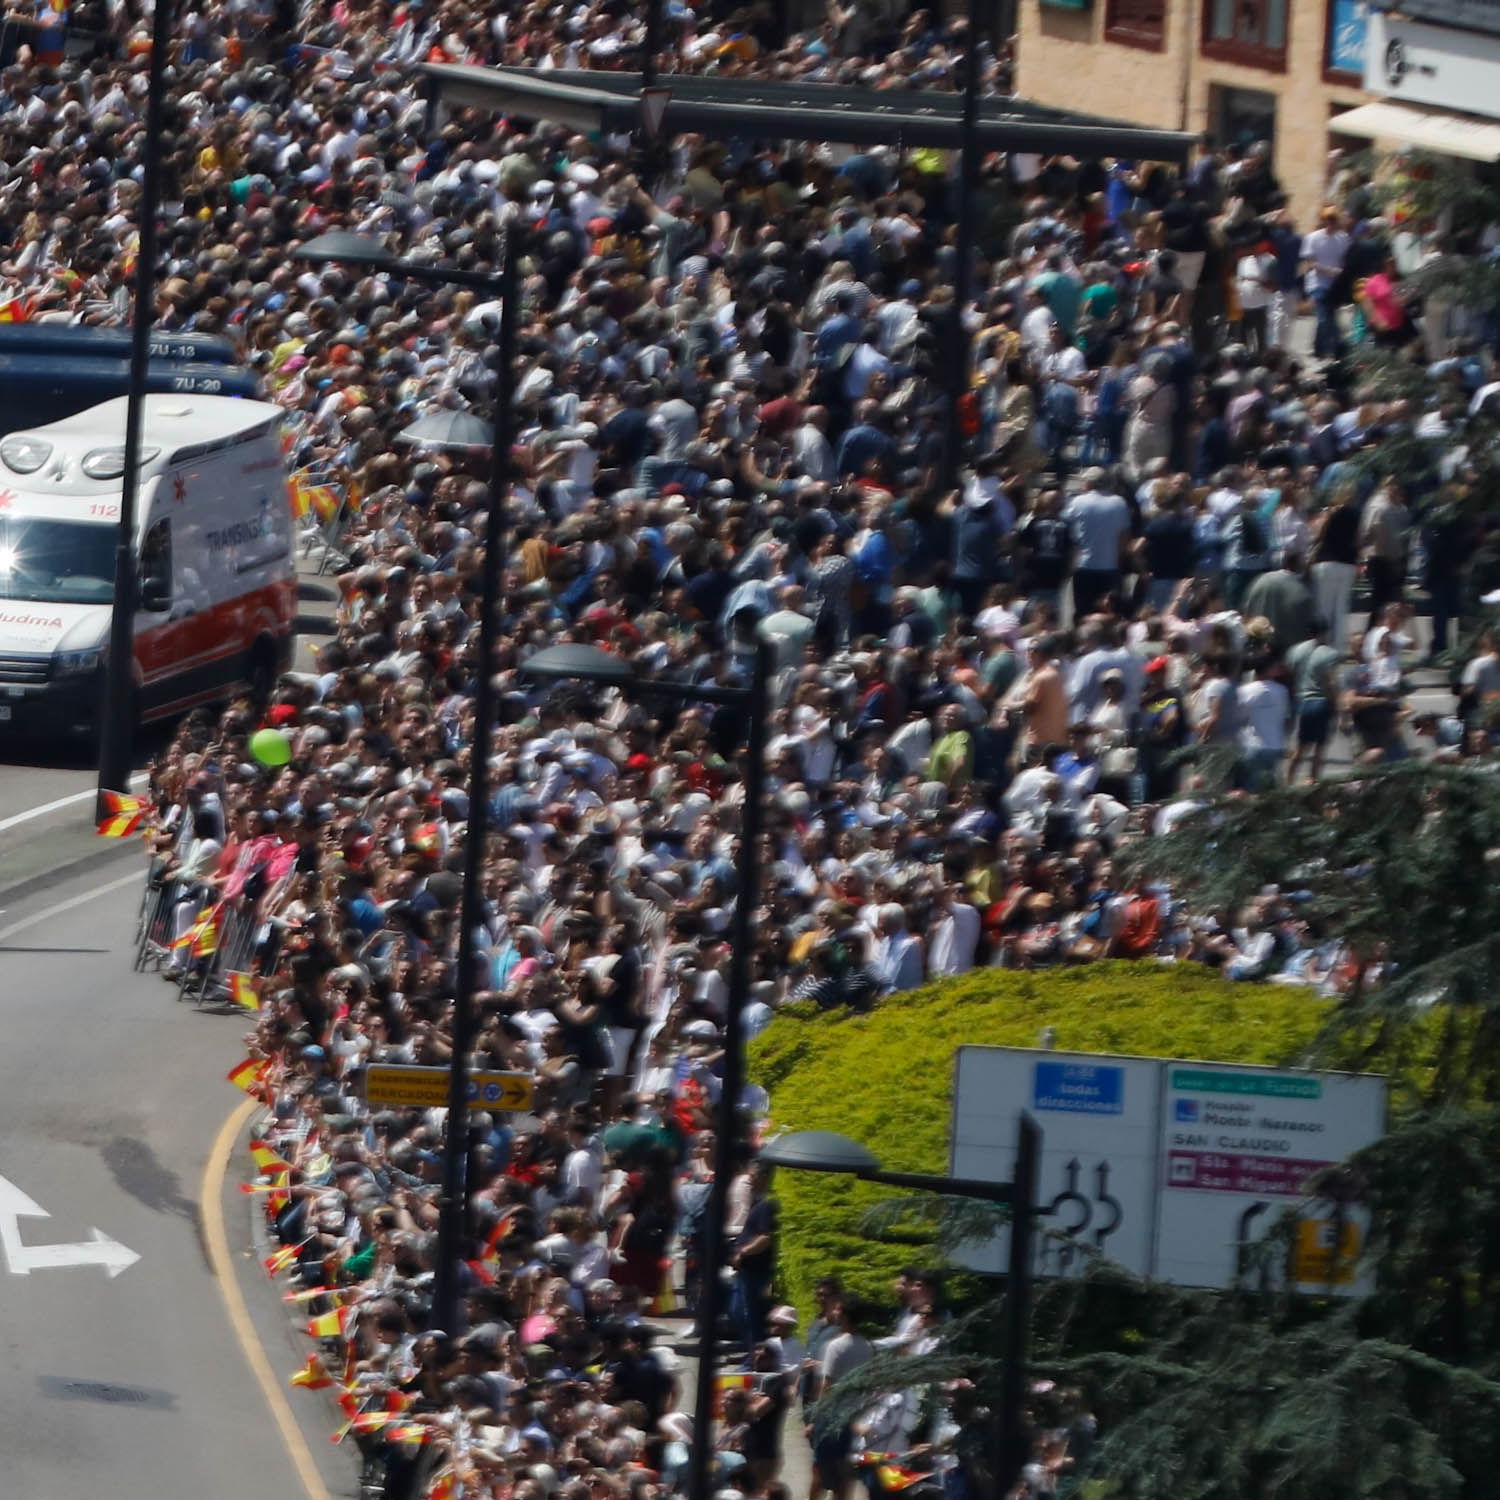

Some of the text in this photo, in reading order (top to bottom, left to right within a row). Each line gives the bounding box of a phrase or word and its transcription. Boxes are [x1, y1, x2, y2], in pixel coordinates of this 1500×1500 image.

[89, 503, 118, 517] 112
[1174, 1134, 1292, 1152] SAN CLAUDIO
